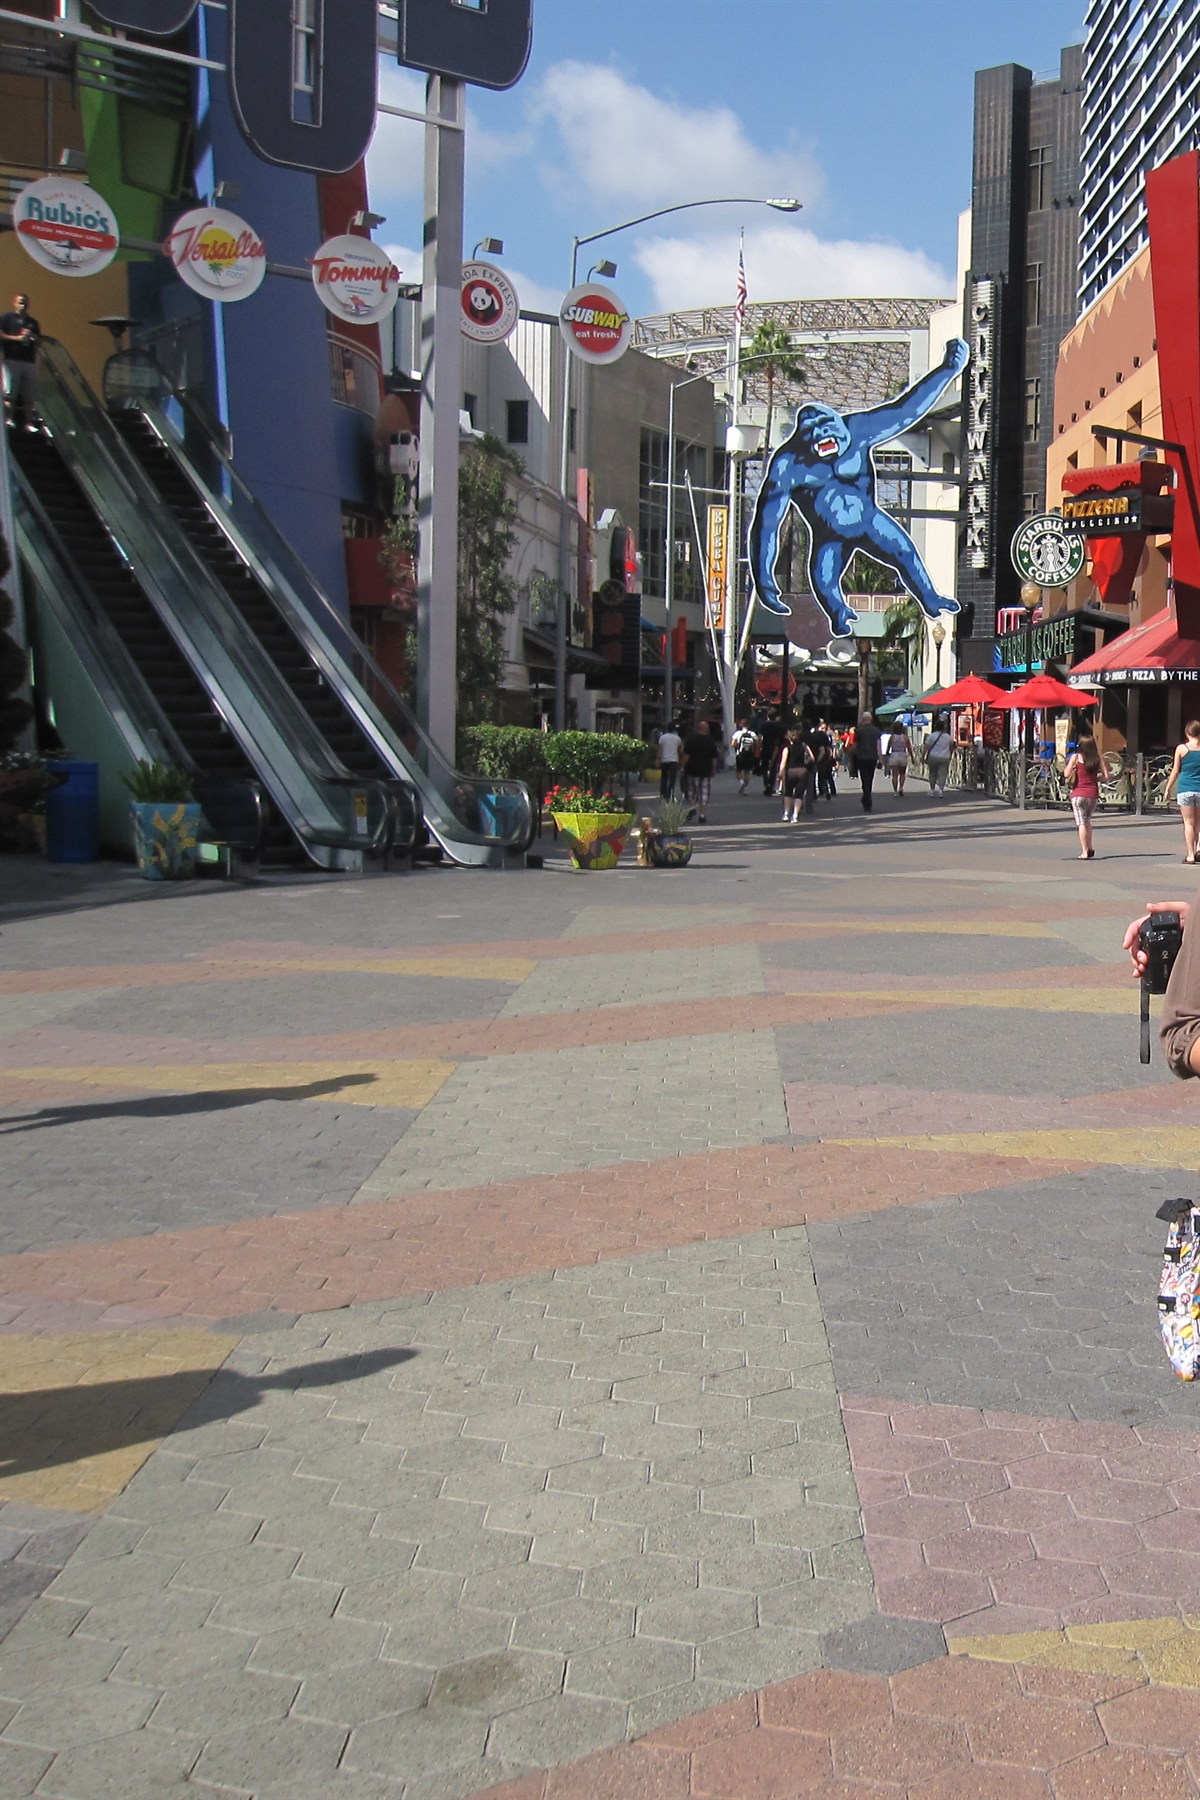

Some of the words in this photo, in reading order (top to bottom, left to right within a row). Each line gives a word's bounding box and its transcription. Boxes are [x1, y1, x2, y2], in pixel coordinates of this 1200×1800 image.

[26, 196, 110, 236] Rubio's
[161, 219, 267, 268] Versailles
[308, 257, 400, 294] Tommy's
[482, 269, 514, 307] EXPRESS
[560, 304, 631, 330] SUBWAY
[575, 330, 592, 339] eat
[592, 329, 621, 340] fresh.
[966, 301, 989, 547] CITYWALK
[1063, 496, 1130, 518] PIZZERIA
[713, 509, 725, 574] BUBBA
[1019, 519, 1081, 553] STARBUS
[1027, 564, 1076, 583] COFFEE
[1000, 627, 1043, 668] TARBUKS
[1043, 616, 1076, 660] COFFEE
[1132, 670, 1156, 680] PIZZA
[1161, 670, 1174, 680] BY
[1177, 671, 1198, 681] THE
